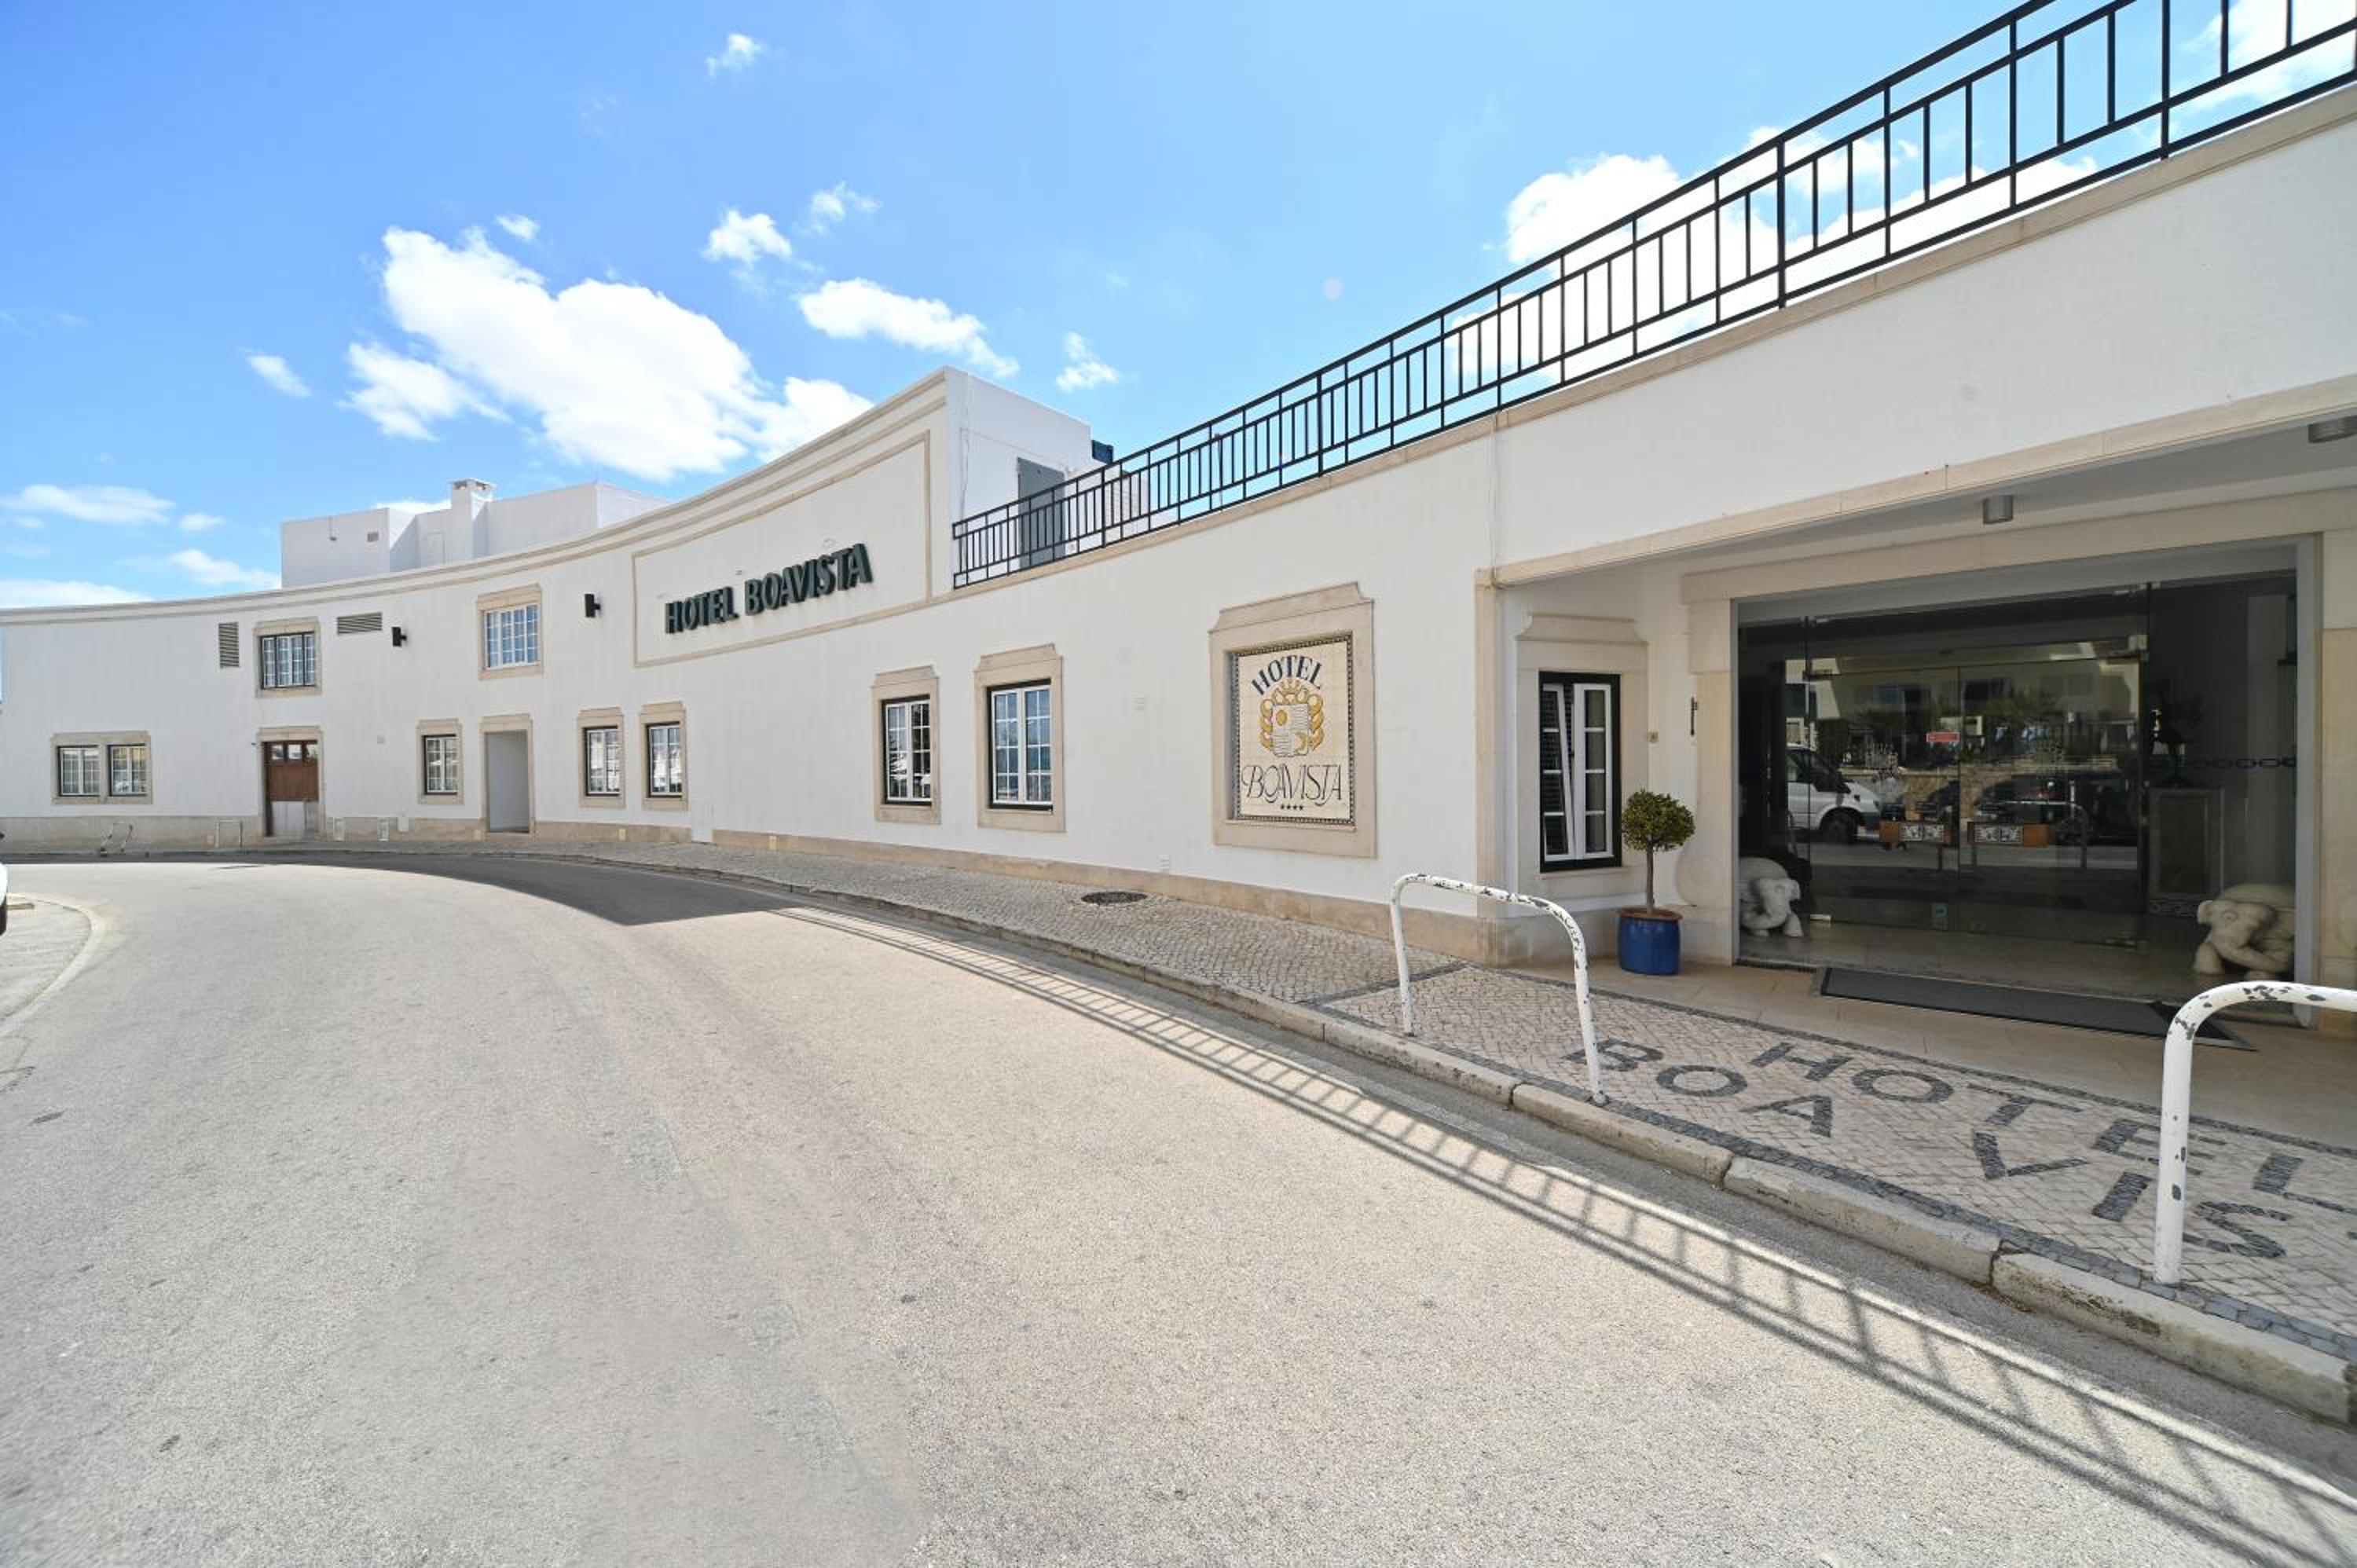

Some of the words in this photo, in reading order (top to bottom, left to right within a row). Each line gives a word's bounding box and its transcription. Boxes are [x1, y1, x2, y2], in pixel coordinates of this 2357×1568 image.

[665, 585, 740, 634] HOTEL
[744, 543, 874, 616] BOAVISTA
[1251, 655, 1323, 696] HOTEL
[1241, 763, 1342, 807] BOAVISTA
[1748, 1041, 2357, 1215] HOTEL
[1972, 1129, 2357, 1258] VIS
